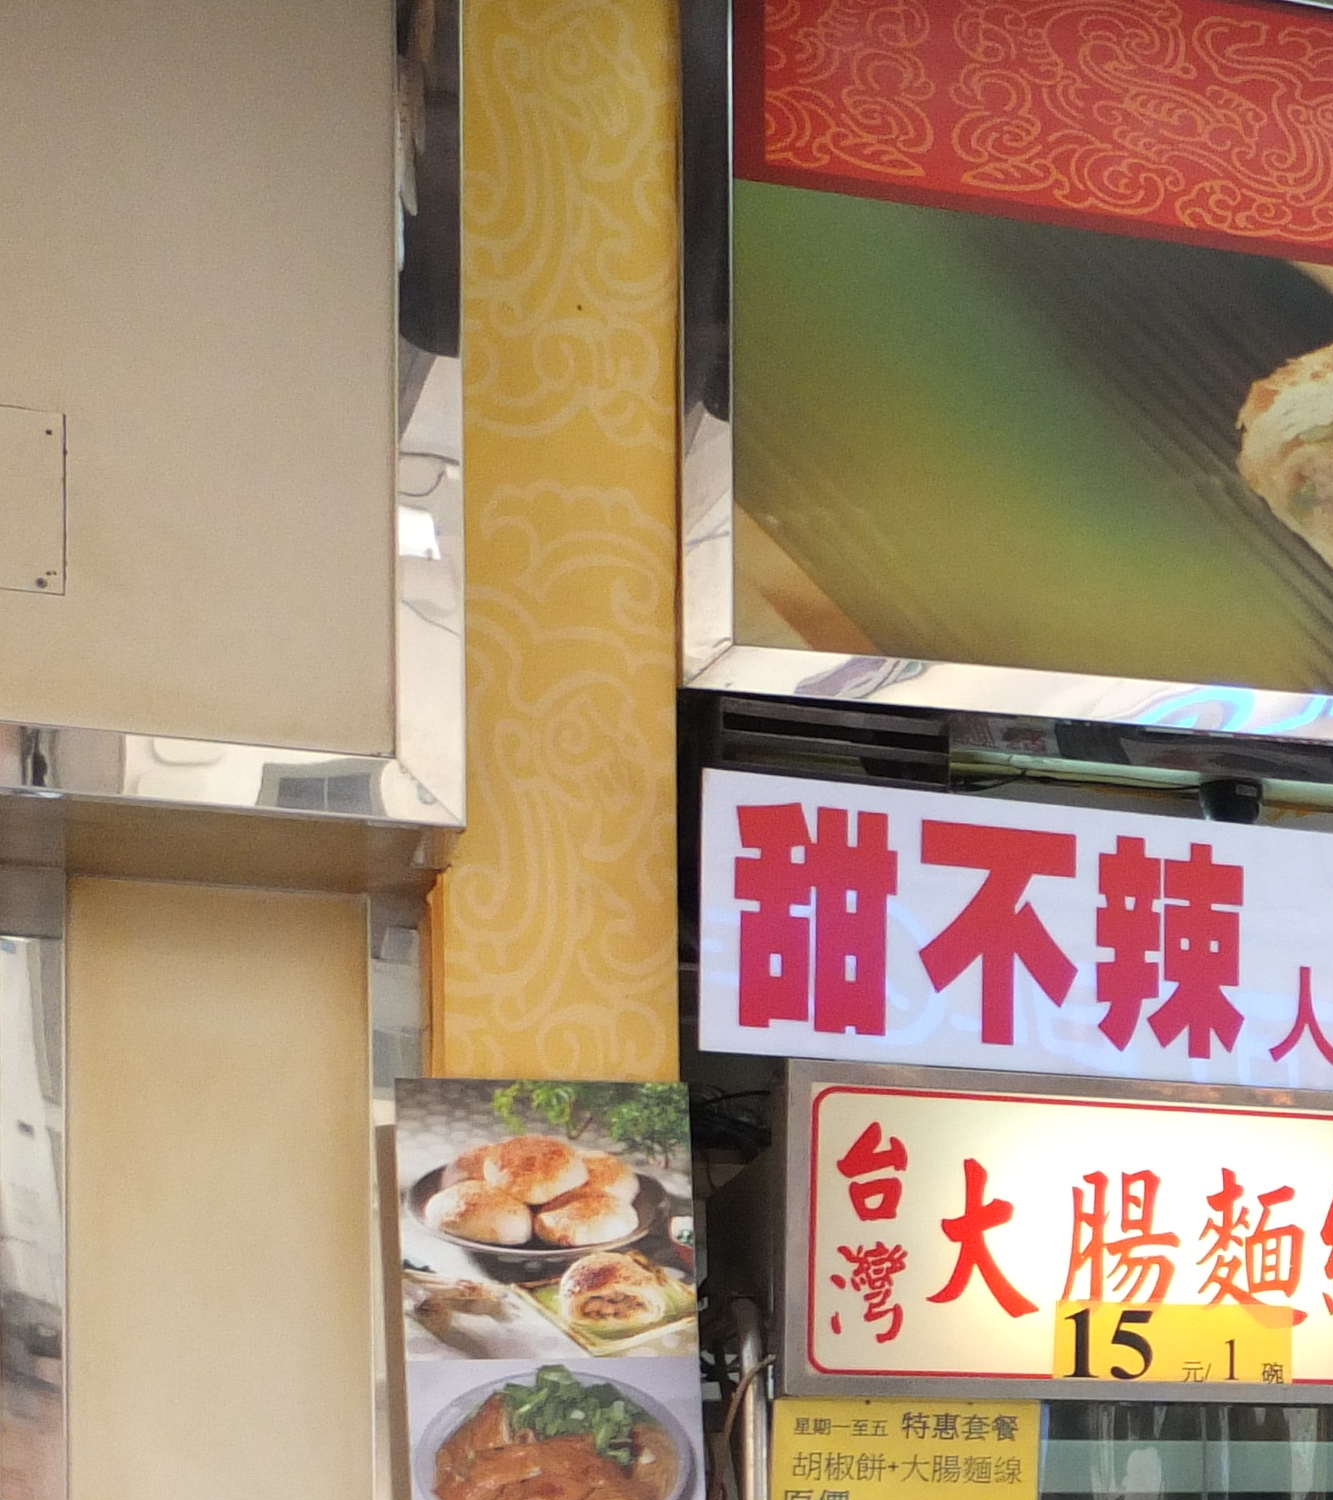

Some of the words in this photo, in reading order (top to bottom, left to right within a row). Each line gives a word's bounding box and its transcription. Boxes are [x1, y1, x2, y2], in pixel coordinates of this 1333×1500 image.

[734, 802, 1245, 1060] 甜不辣
[829, 1121, 909, 1345] 台灣
[1062, 1308, 1155, 1382] 15
[793, 1416, 889, 1437] 星期一至五
[901, 1410, 1019, 1442] 特惠套餐
